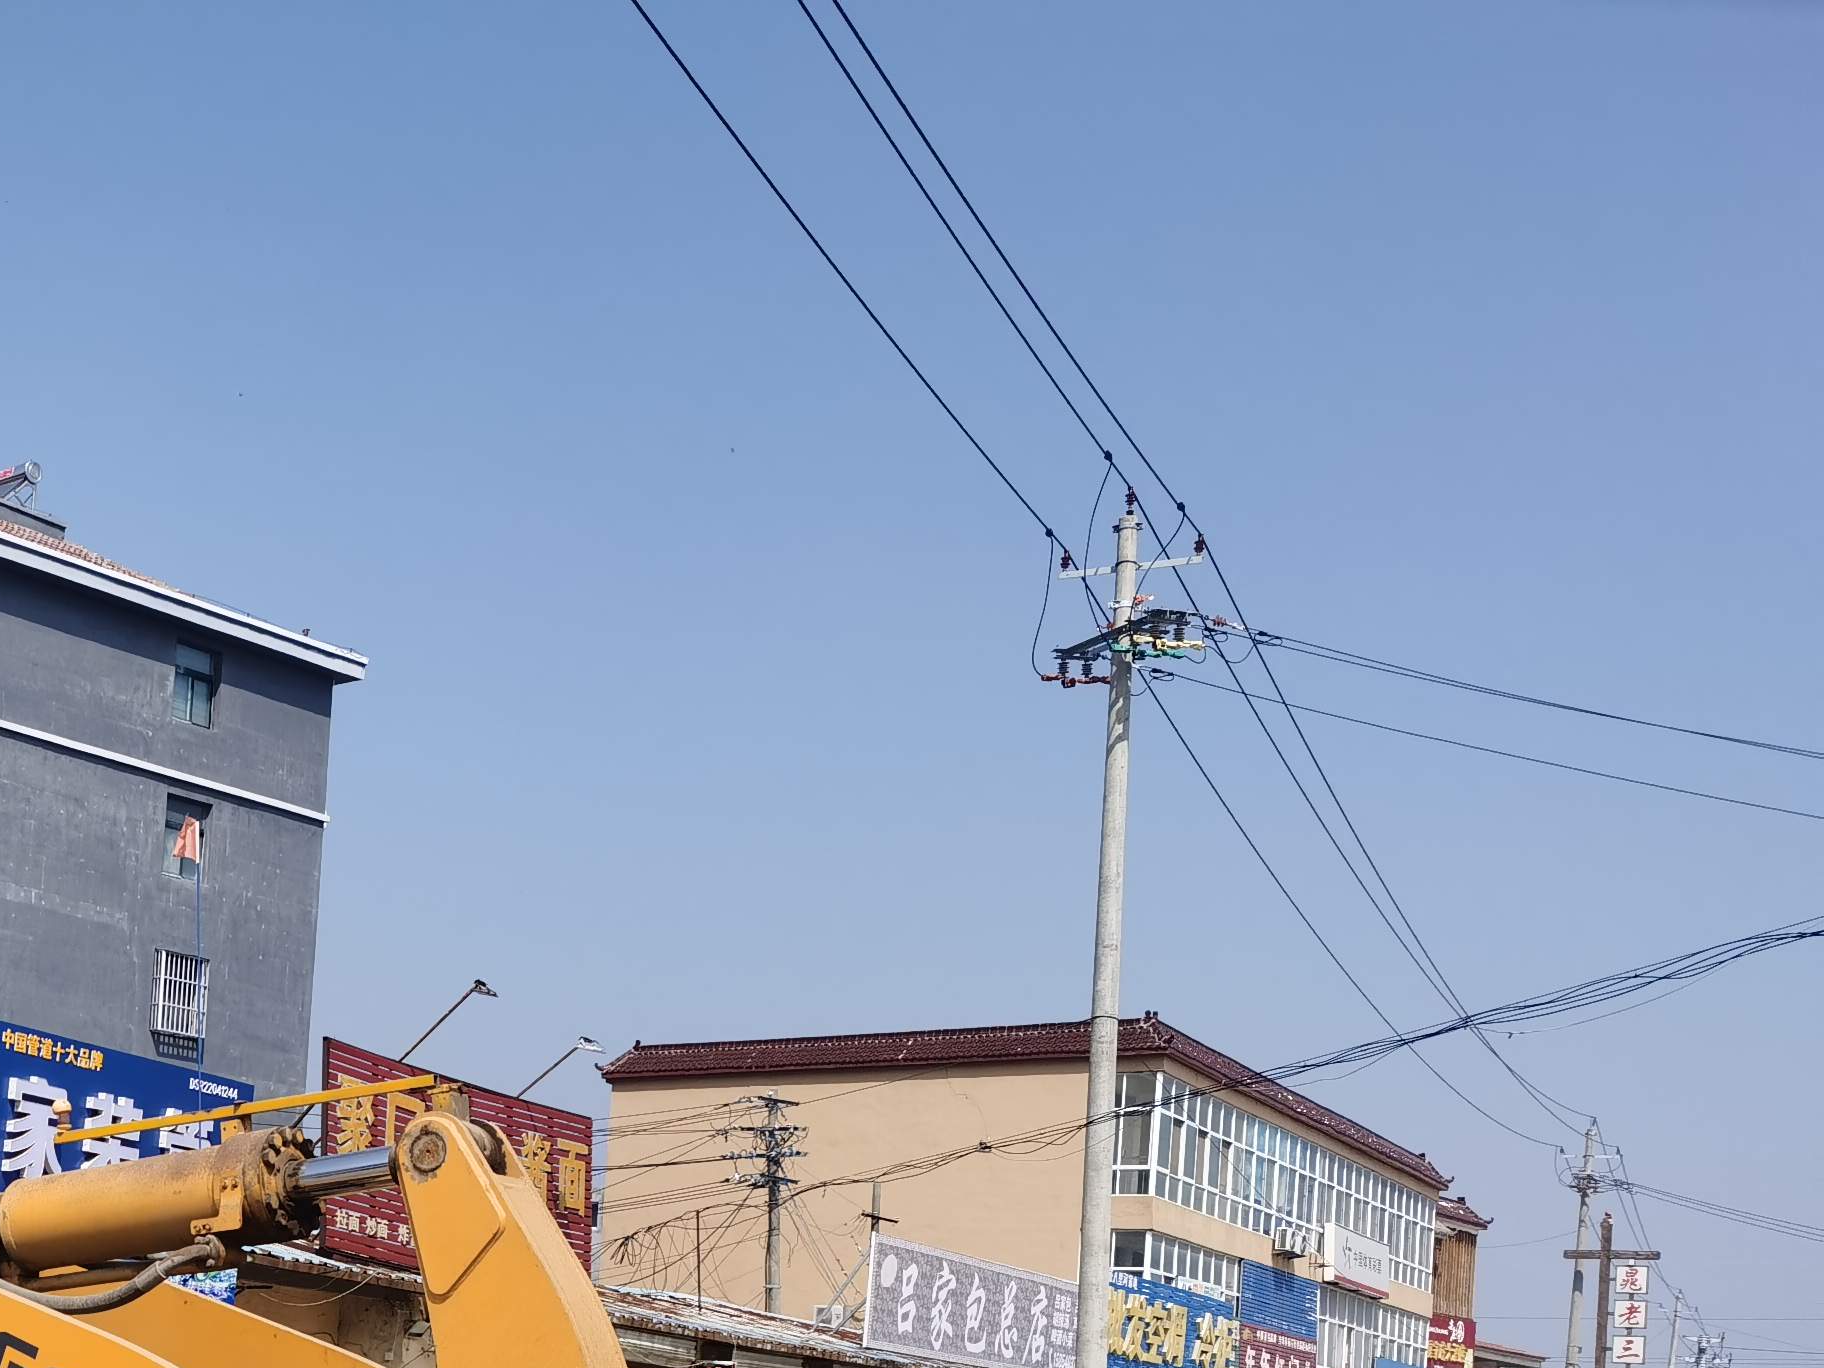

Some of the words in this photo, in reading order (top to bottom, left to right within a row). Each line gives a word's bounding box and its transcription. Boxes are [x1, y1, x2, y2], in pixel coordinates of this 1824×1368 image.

[2, 1028, 104, 1072] 中国管道十大品牌
[335, 1208, 360, 1232] 拉面
[366, 1216, 389, 1239] 炒面
